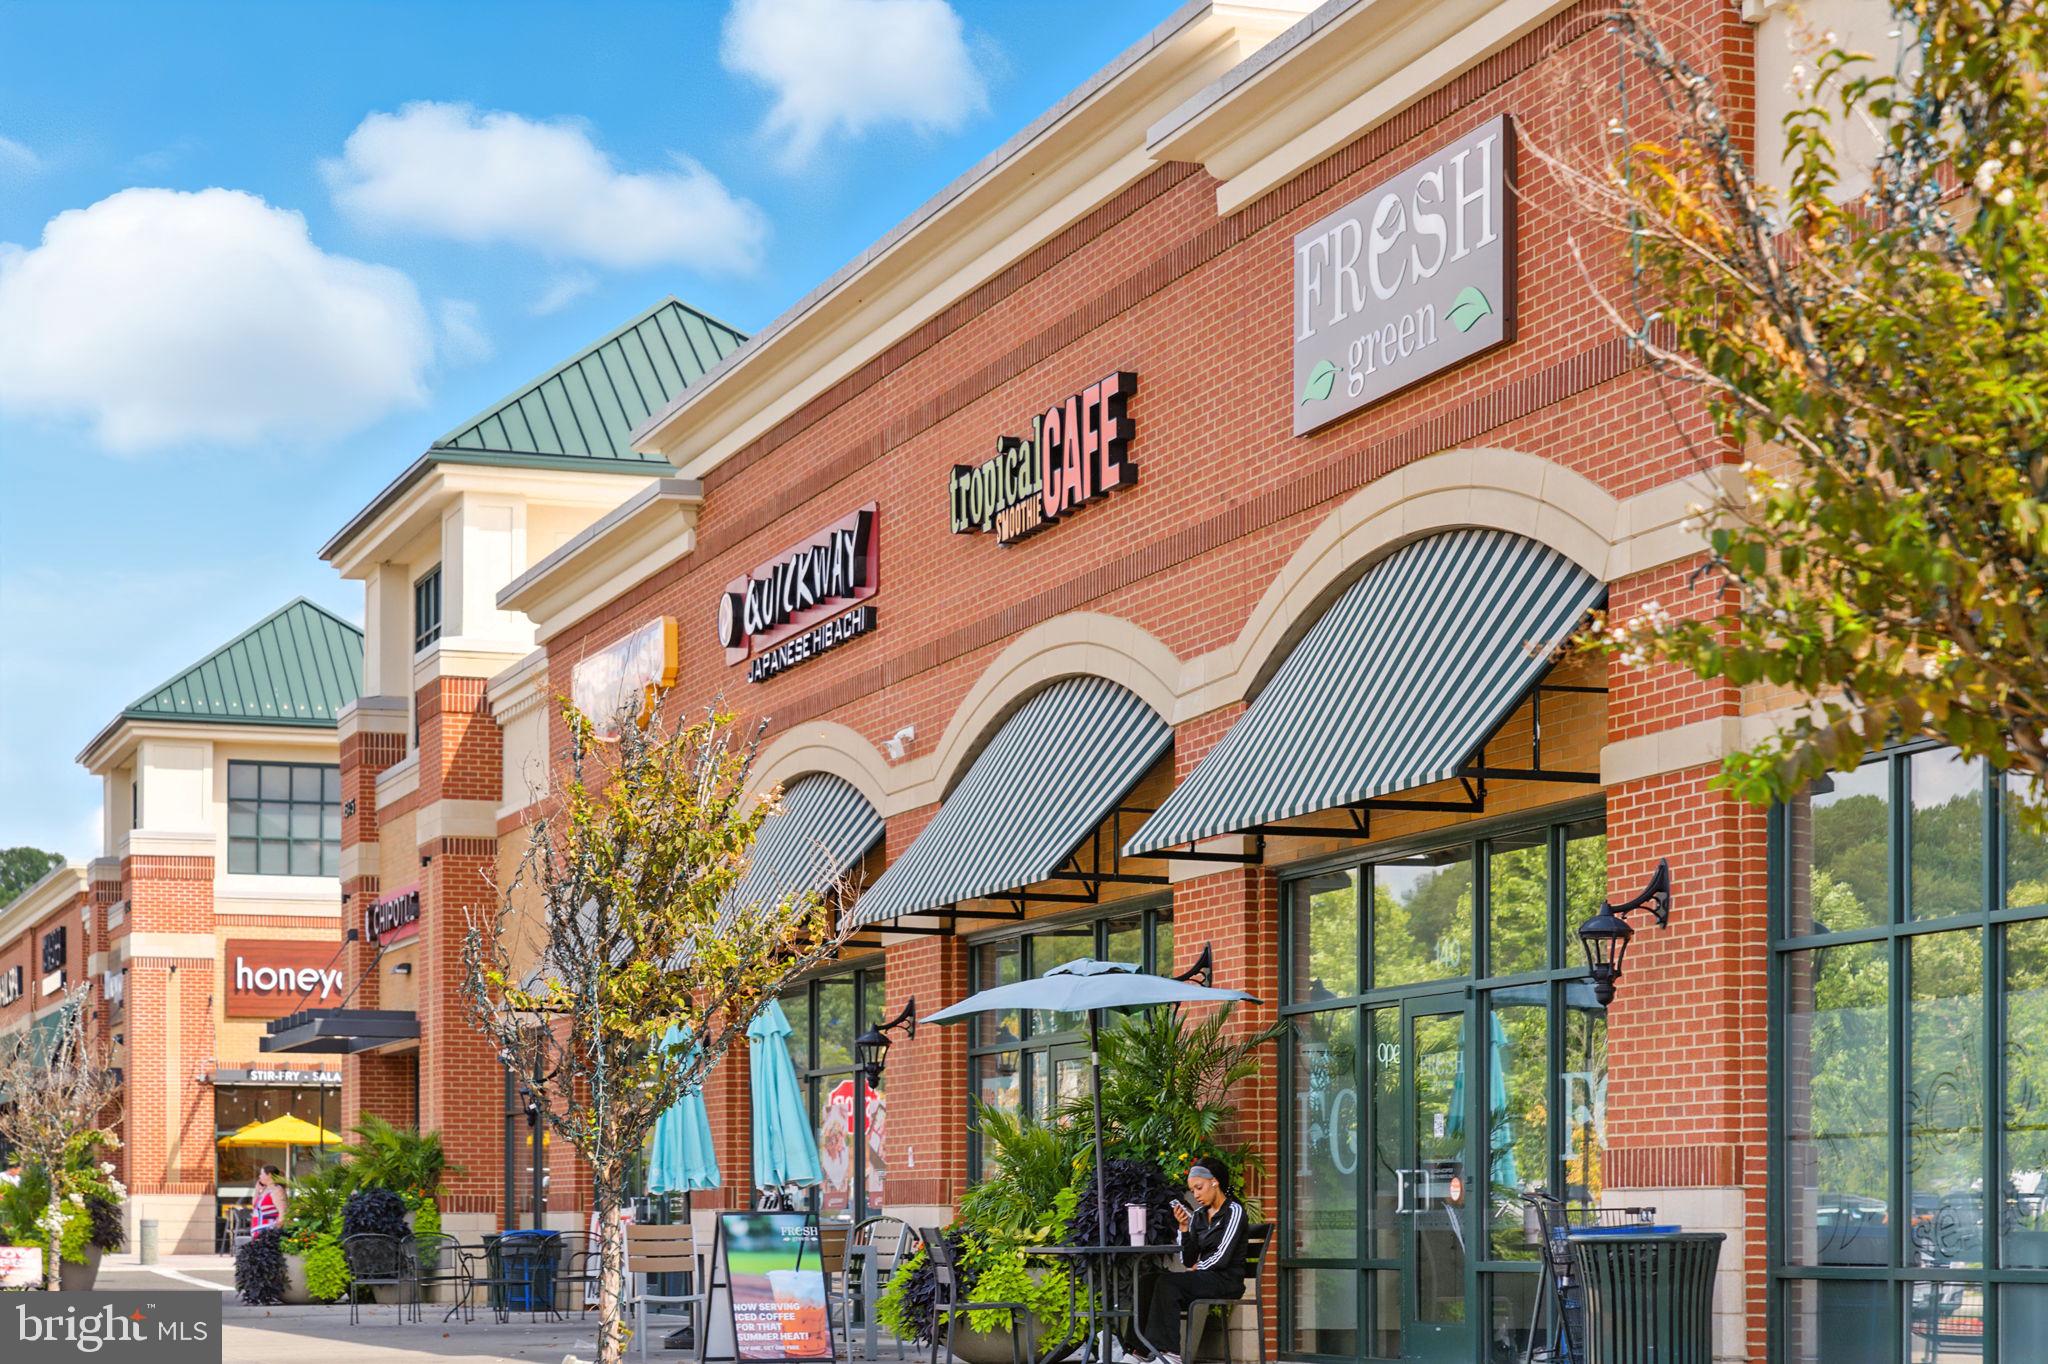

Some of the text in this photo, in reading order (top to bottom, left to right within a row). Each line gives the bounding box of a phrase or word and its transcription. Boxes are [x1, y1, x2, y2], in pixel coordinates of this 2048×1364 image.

[1347, 302, 1438, 398] green
[950, 372, 1120, 534] tropical CAFE
[996, 494, 1042, 544] SMOOTHIE
[744, 511, 861, 636] QUICKWAY
[747, 607, 866, 683] JAPANESE HIBACHI
[250, 1070, 300, 1082] STIR-FRY
[733, 1302, 801, 1311] NOW SERVING
[734, 1312, 796, 1321] ICED COFFEE
[736, 1323, 782, 1331] FOR THAT
[737, 1332, 809, 1341] SUMMER HEAT!
